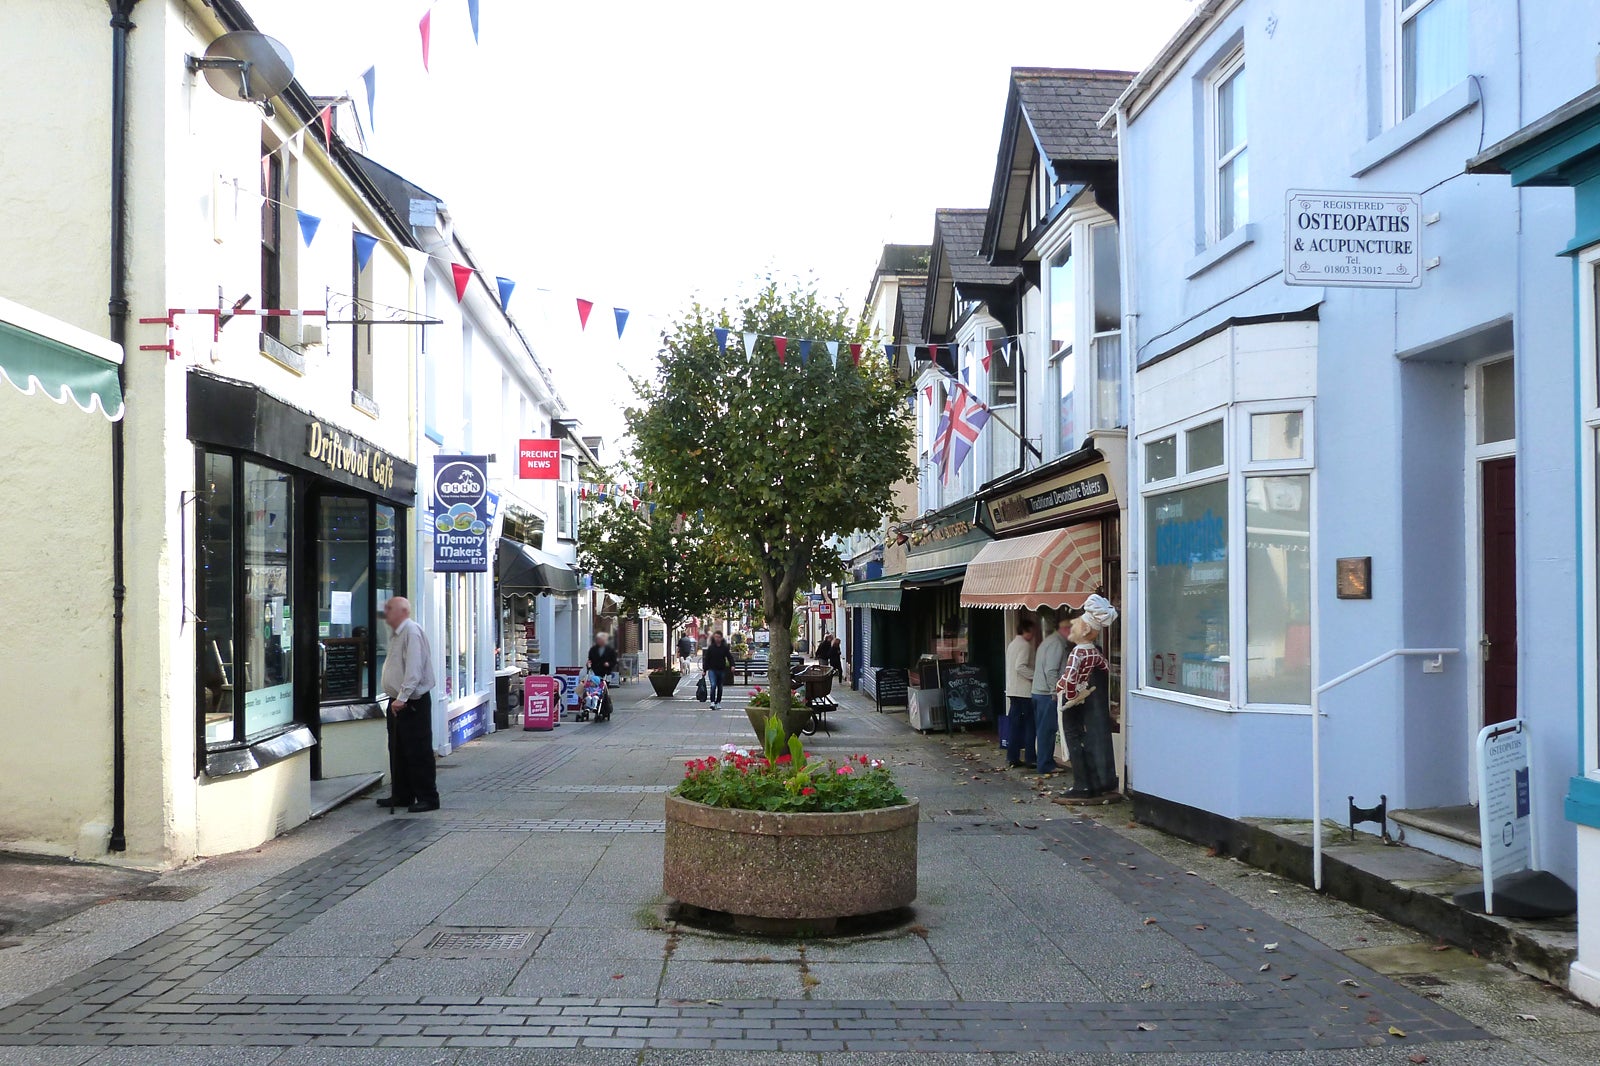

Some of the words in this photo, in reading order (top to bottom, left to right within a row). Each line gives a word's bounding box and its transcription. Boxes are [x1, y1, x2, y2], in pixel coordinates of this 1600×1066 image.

[1323, 201, 1384, 210] REGISTERED
[1298, 212, 1410, 233] OSTEOPATHS
[1294, 238, 1305, 251] &
[1309, 238, 1413, 254] ACUPUNCTURE
[1346, 256, 1361, 265] Tel.
[1324, 265, 1350, 274] 01803
[1352, 266, 1383, 275] 313012
[309, 421, 370, 479] Driftwood
[373, 451, 394, 491] Café
[520, 450, 558, 459] PRECINCT
[527, 460, 551, 468] NEWS
[442, 483, 480, 492] THHN
[1029, 493, 1054, 511] Traditional
[1053, 486, 1082, 505] Devonshire
[1081, 480, 1101, 496] Bakers
[436, 533, 485, 547] Memory
[440, 546, 483, 557] Makers
